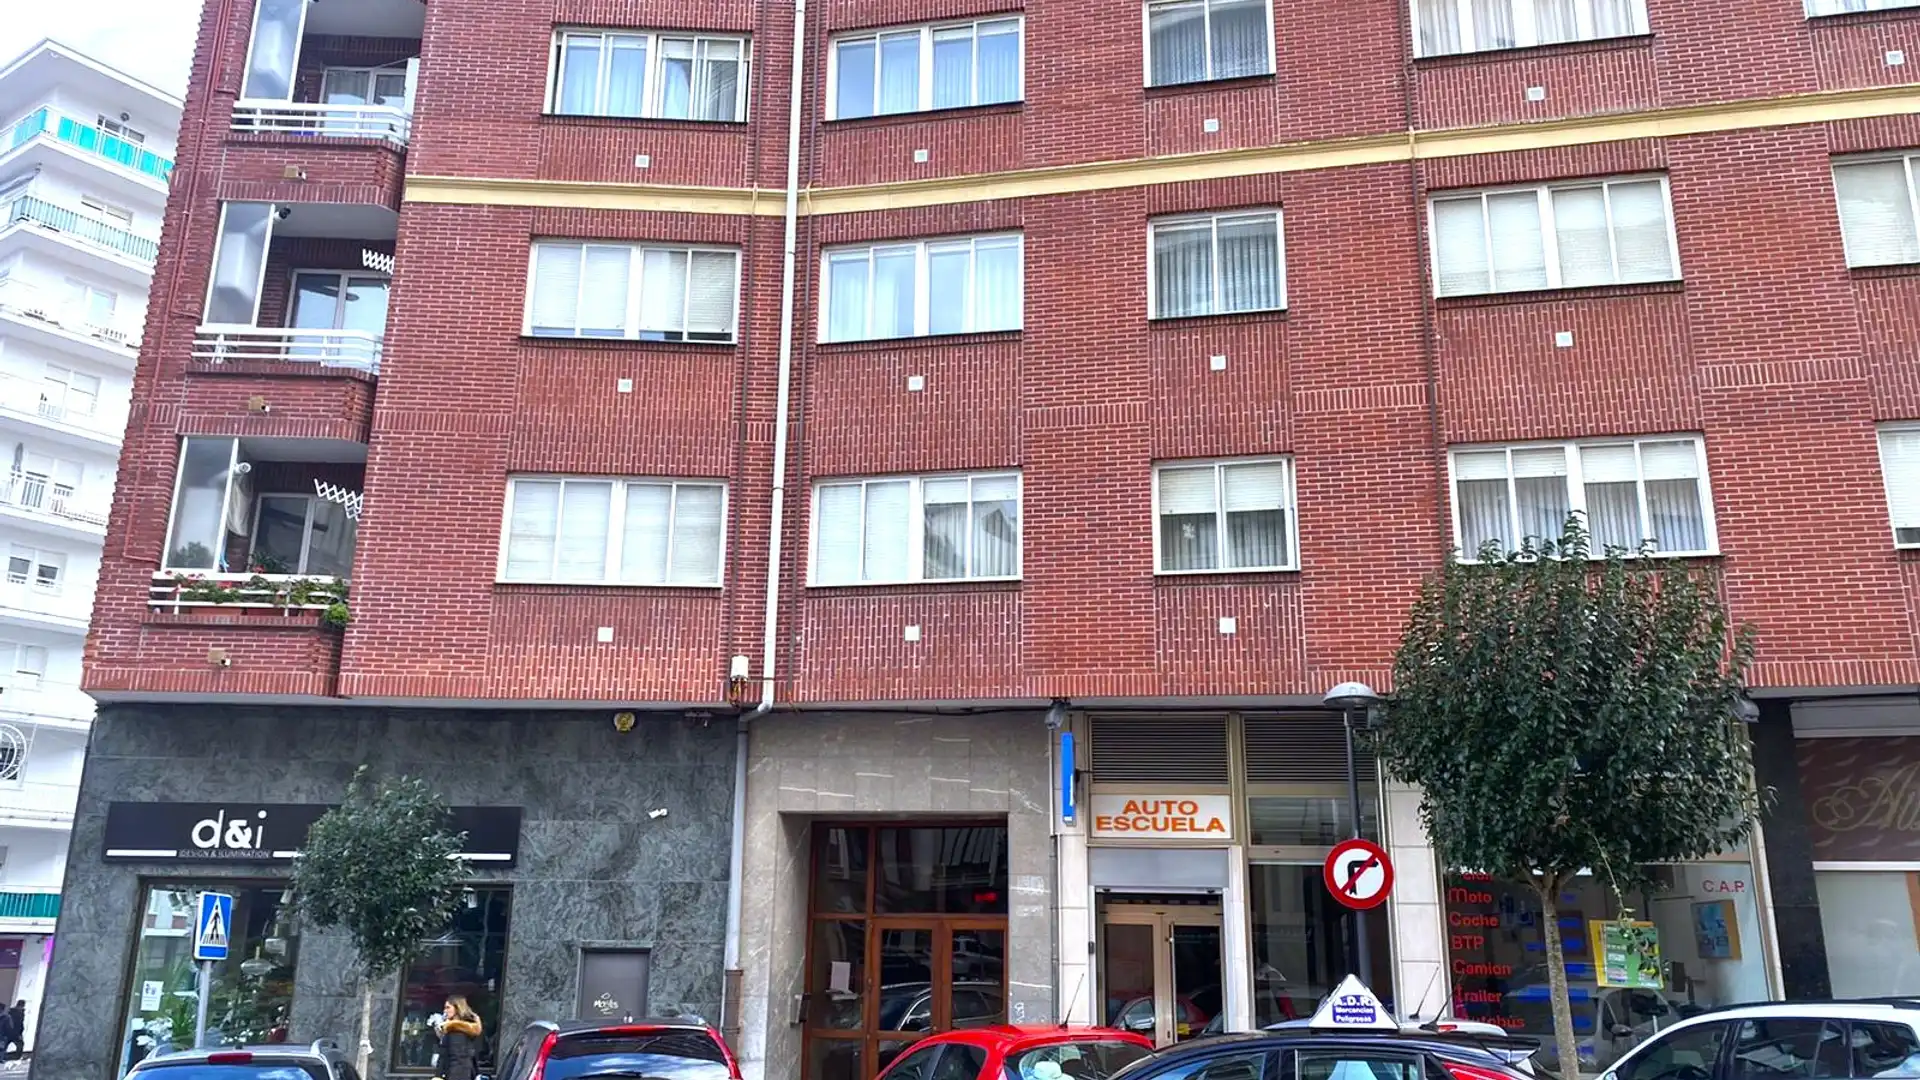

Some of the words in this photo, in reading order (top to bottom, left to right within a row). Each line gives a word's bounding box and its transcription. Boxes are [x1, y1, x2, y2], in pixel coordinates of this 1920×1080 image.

[1122, 799, 1199, 816] AUTO
[191, 809, 267, 849] d&i
[1095, 816, 1226, 832] ESCUELA
[1449, 887, 1493, 904] Moto
[1449, 911, 1499, 927] Coche
[1452, 934, 1485, 950] BTP
